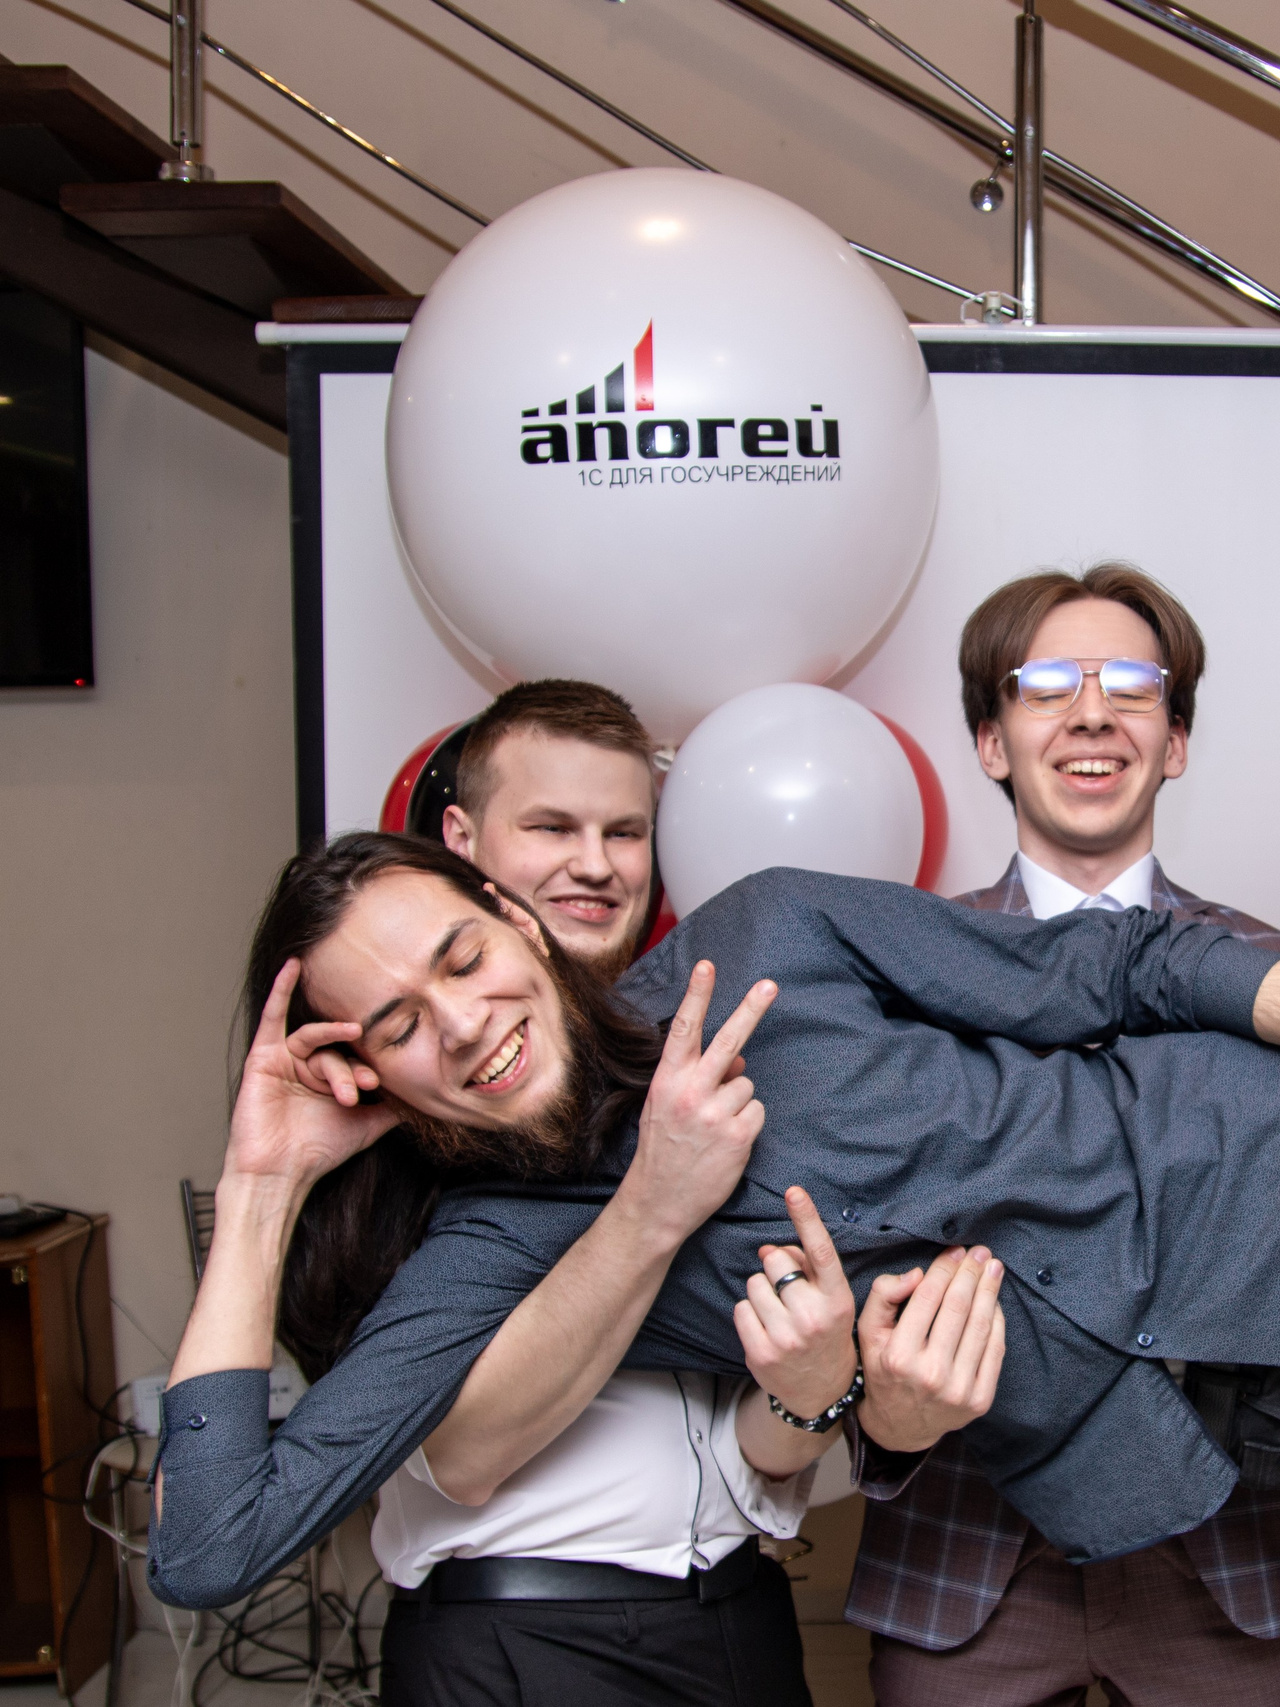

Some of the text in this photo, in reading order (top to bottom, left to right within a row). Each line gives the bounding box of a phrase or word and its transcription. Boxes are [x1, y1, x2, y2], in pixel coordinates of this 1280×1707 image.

[520, 404, 841, 464] апогей
[578, 462, 842, 488] 1С ДЛЯ ГОСУЧРЕЖДЕНИЙ
